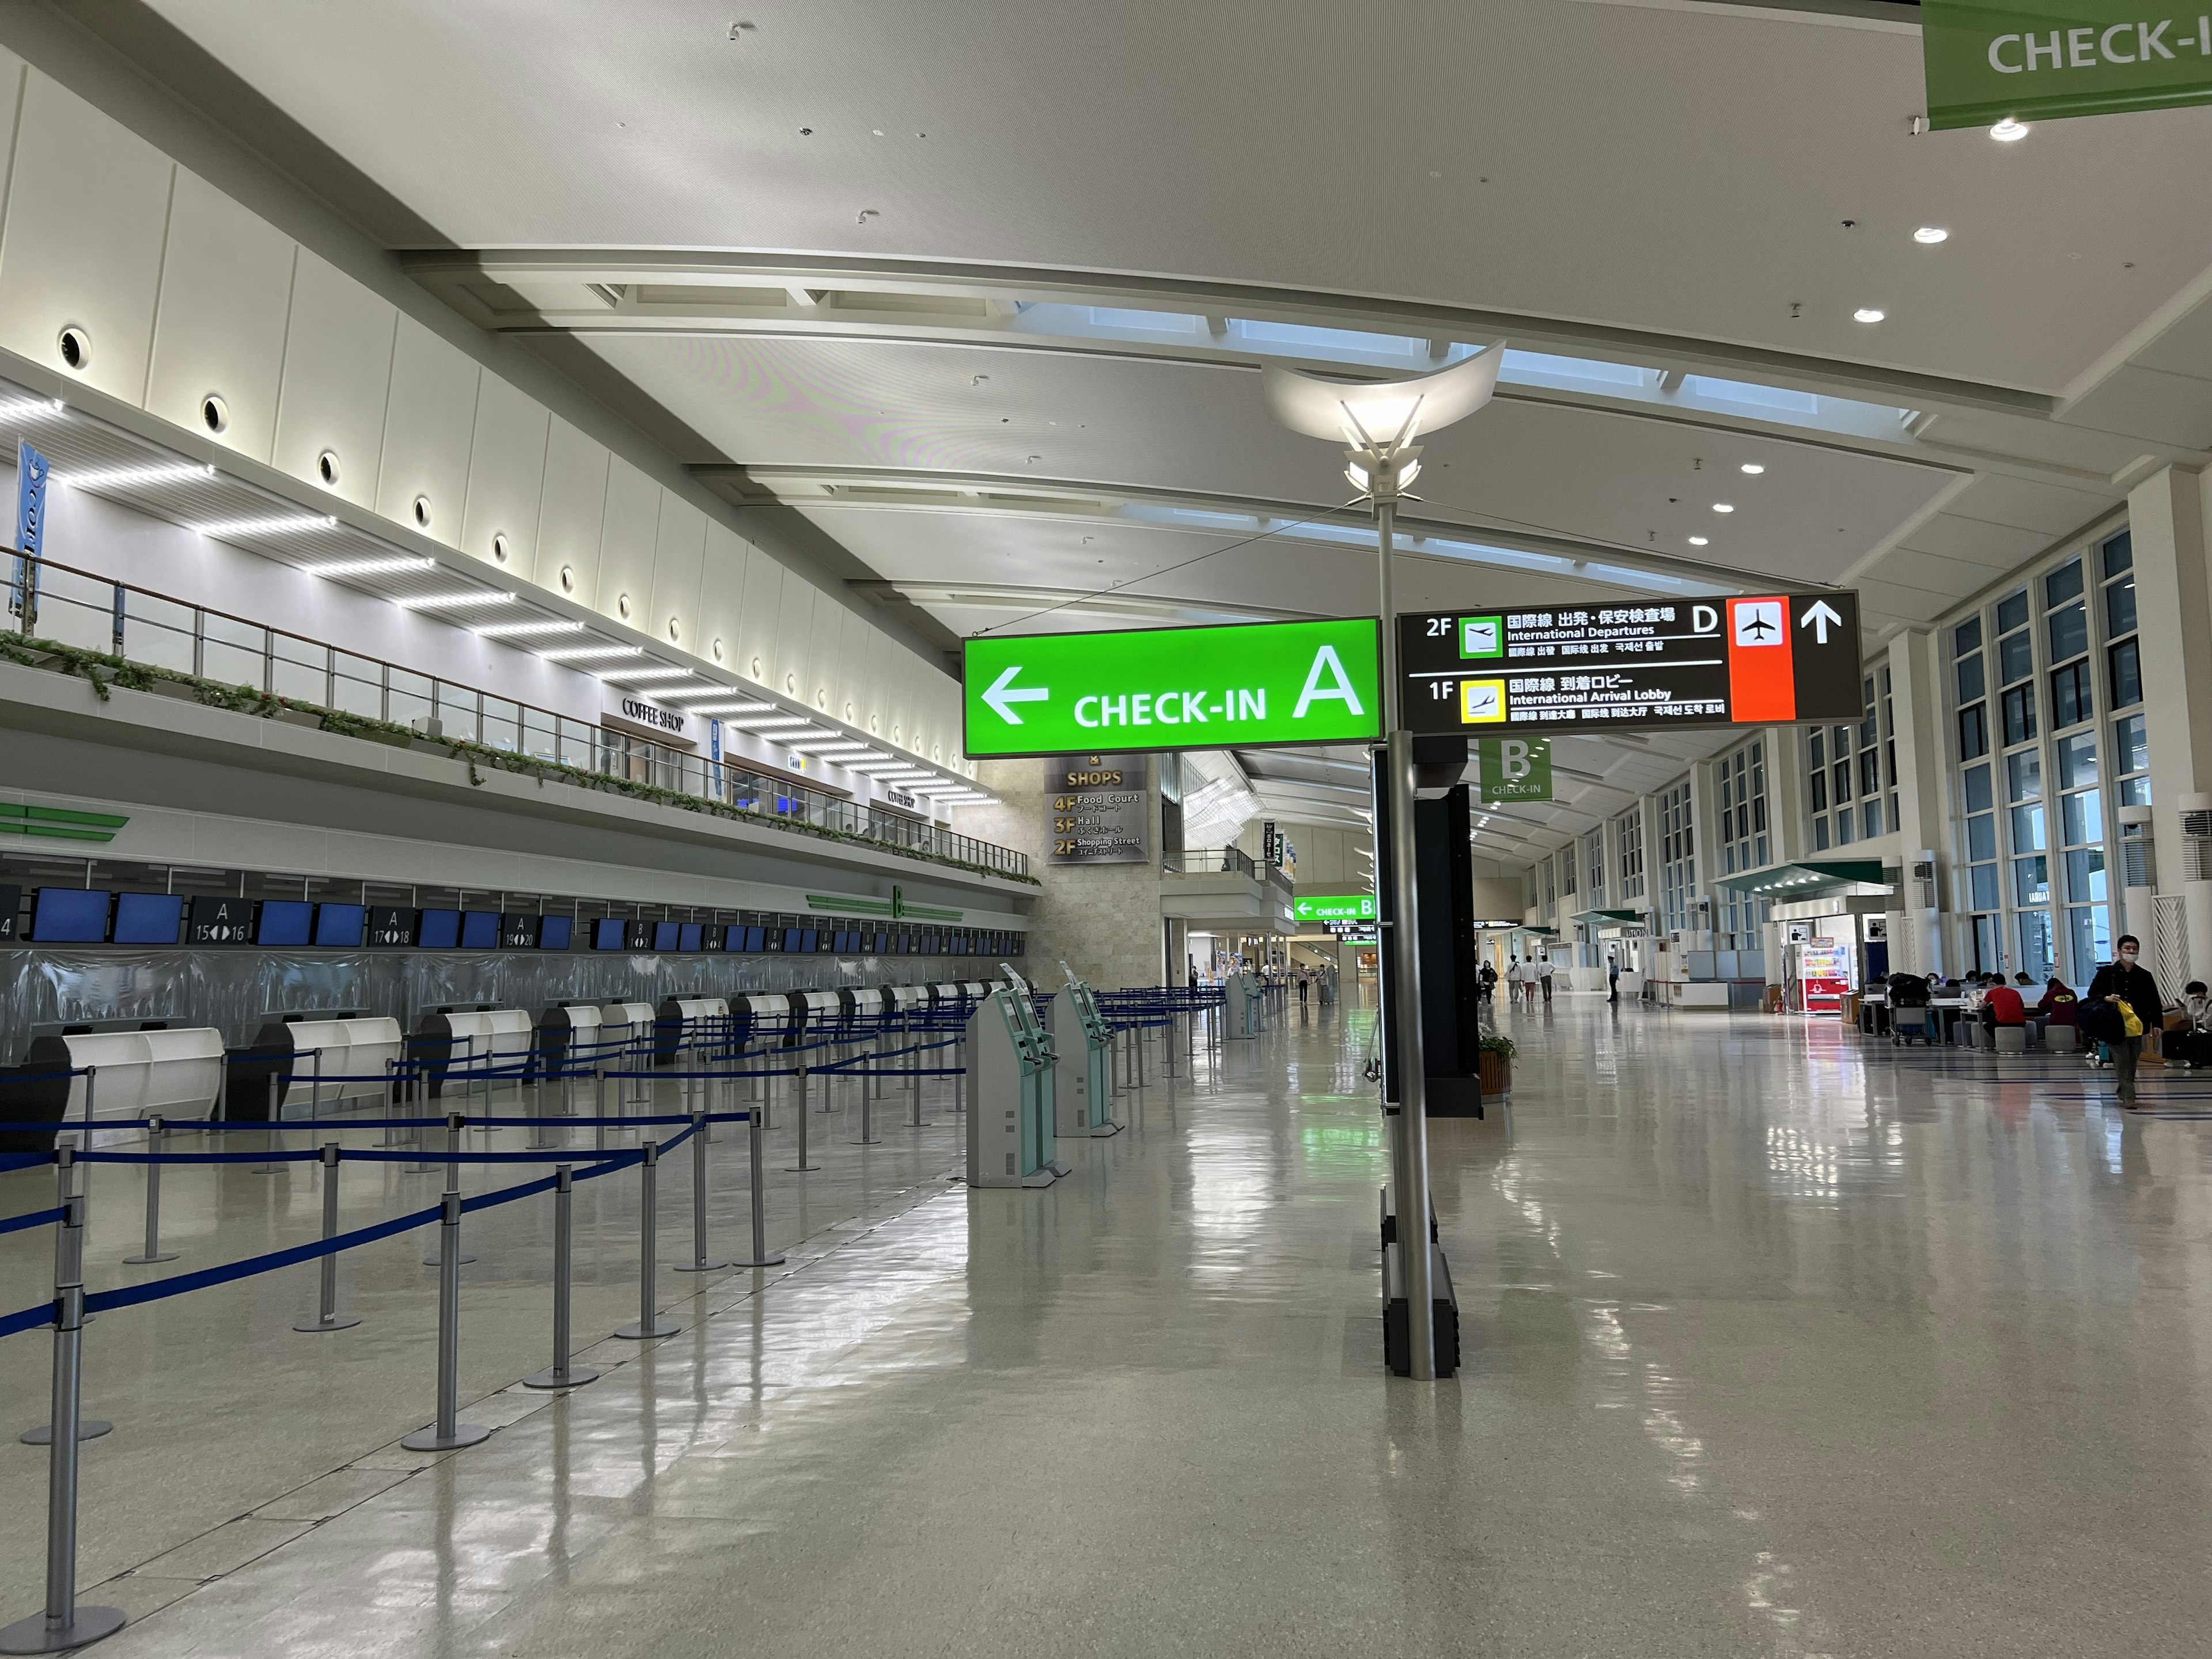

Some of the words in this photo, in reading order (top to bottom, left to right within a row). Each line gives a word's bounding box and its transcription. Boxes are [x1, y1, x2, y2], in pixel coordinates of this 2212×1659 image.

[1507, 613, 1553, 629] 国際線
[1558, 607, 1675, 626] 出発・保安検査場
[1692, 605, 1718, 633] D
[1427, 618, 1452, 636] 2F
[1508, 628, 1584, 641] International
[1588, 626, 1654, 639] Departures
[1074, 689, 1266, 728] CHECK-IN
[1291, 645, 1365, 718] A
[1430, 681, 1453, 700] 1F
[1509, 677, 1555, 692] 国際線
[1560, 673, 1633, 691] 到着ロビー
[1510, 691, 1587, 705] International
[1590, 690, 1631, 702] Arrival
[1635, 689, 1671, 701] Lobby
[623, 698, 658, 725] COFFEE
[660, 710, 684, 732] SHOP
[1501, 740, 1531, 779] B
[1067, 770, 1122, 786] SHOPS
[1492, 785, 1540, 794] CHECK-IN
[1054, 796, 1076, 812] 4F
[1077, 794, 1103, 804] Food
[1108, 794, 1139, 804] Court
[1077, 804, 1122, 813] フードコート
[1054, 817, 1076, 833] 3F
[1077, 816, 1100, 825] Hall
[1054, 839, 1076, 855] 2F
[1077, 838, 1112, 847] Shopping
[1113, 836, 1141, 845] Street
[893, 885, 903, 919] B
[217, 903, 228, 920] A
[389, 911, 397, 926] A
[1316, 907, 1356, 916] CHECK-IN
[517, 918, 524, 930] A
[638, 923, 643, 934] B
[712, 927, 717, 937] B
[196, 925, 210, 940] 15
[232, 926, 245, 941] 16
[374, 930, 385, 943] 17
[400, 931, 410, 944] 18
[507, 934, 514, 945] 19
[524, 934, 533, 946] 20
[644, 938, 648, 948] 2
